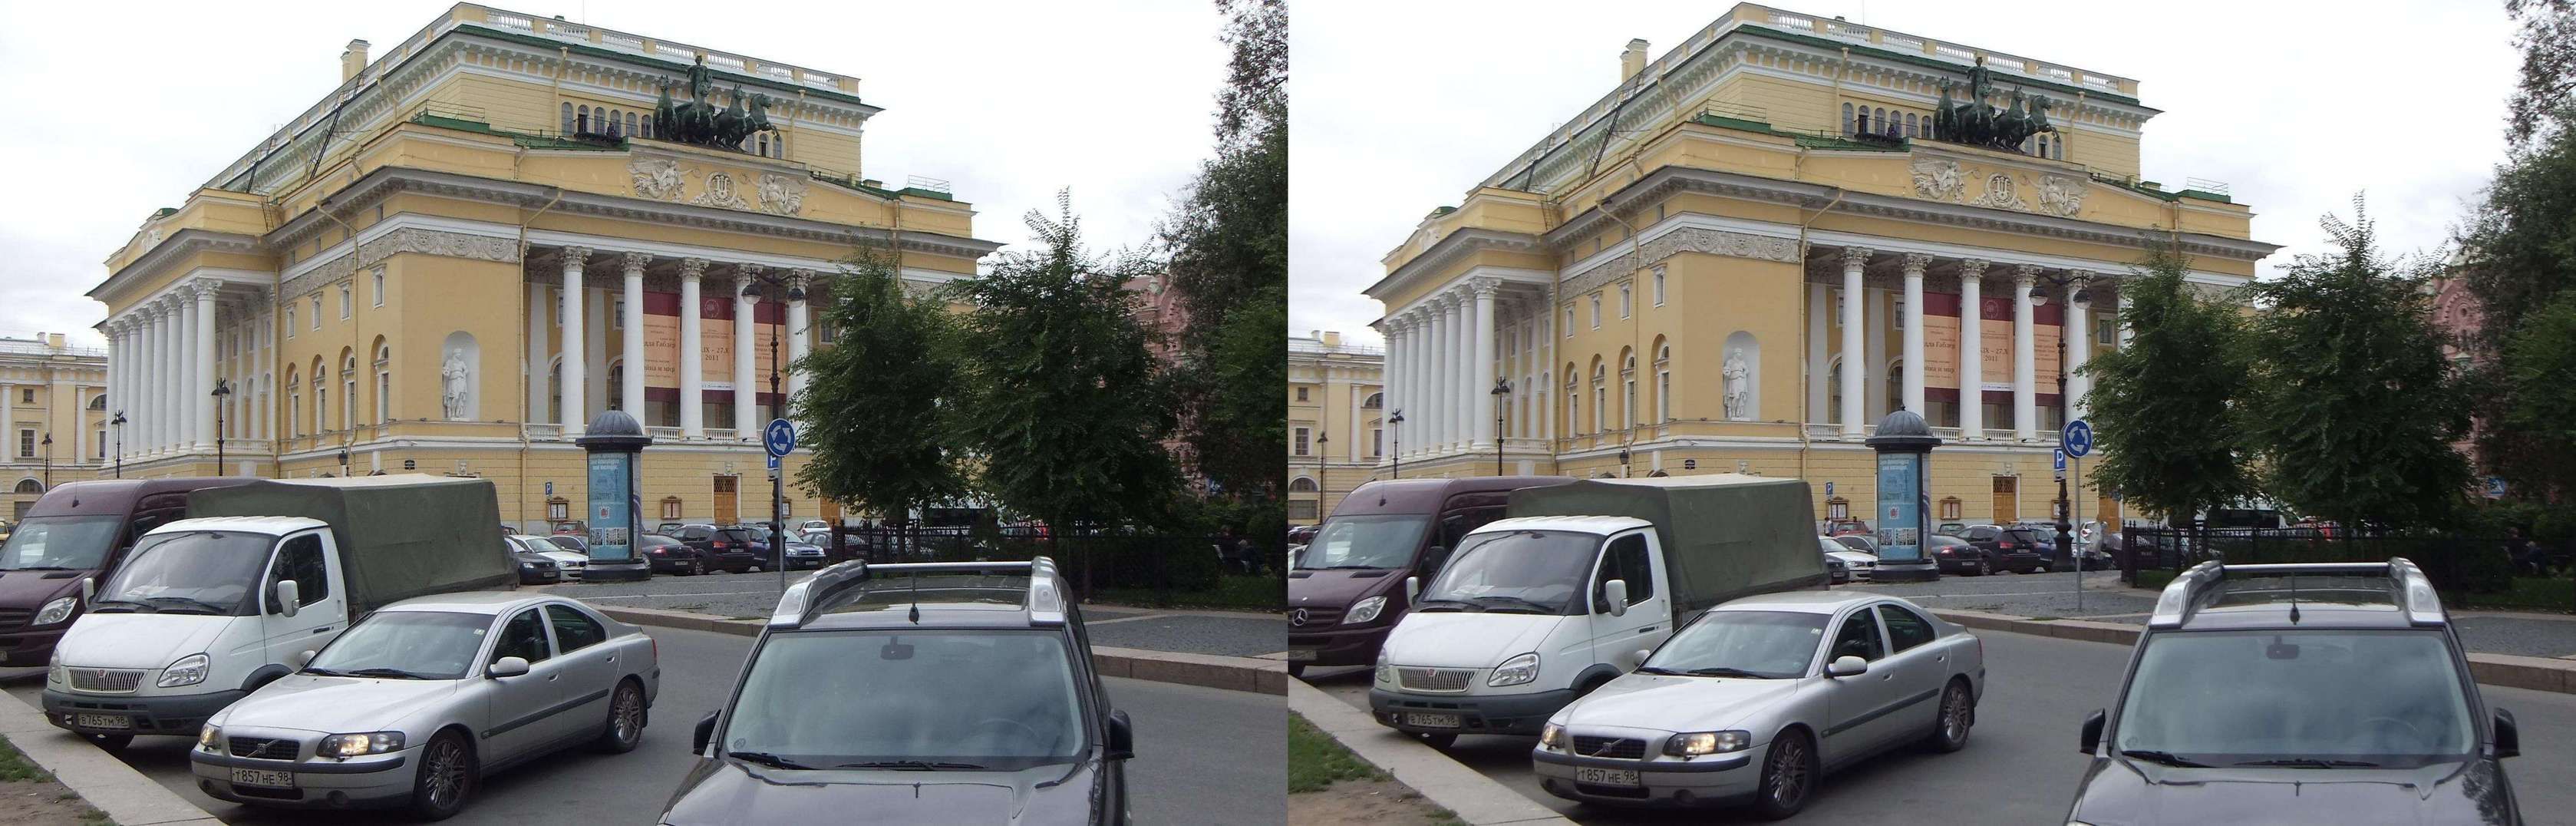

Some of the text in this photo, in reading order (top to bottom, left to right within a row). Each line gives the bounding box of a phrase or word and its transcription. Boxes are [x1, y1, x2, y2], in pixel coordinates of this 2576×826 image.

[2057, 450, 2063, 468] P
[546, 483, 551, 494] P
[1827, 483, 1832, 494] P
[277, 771, 289, 781] 98
[1623, 771, 1635, 781] 98
